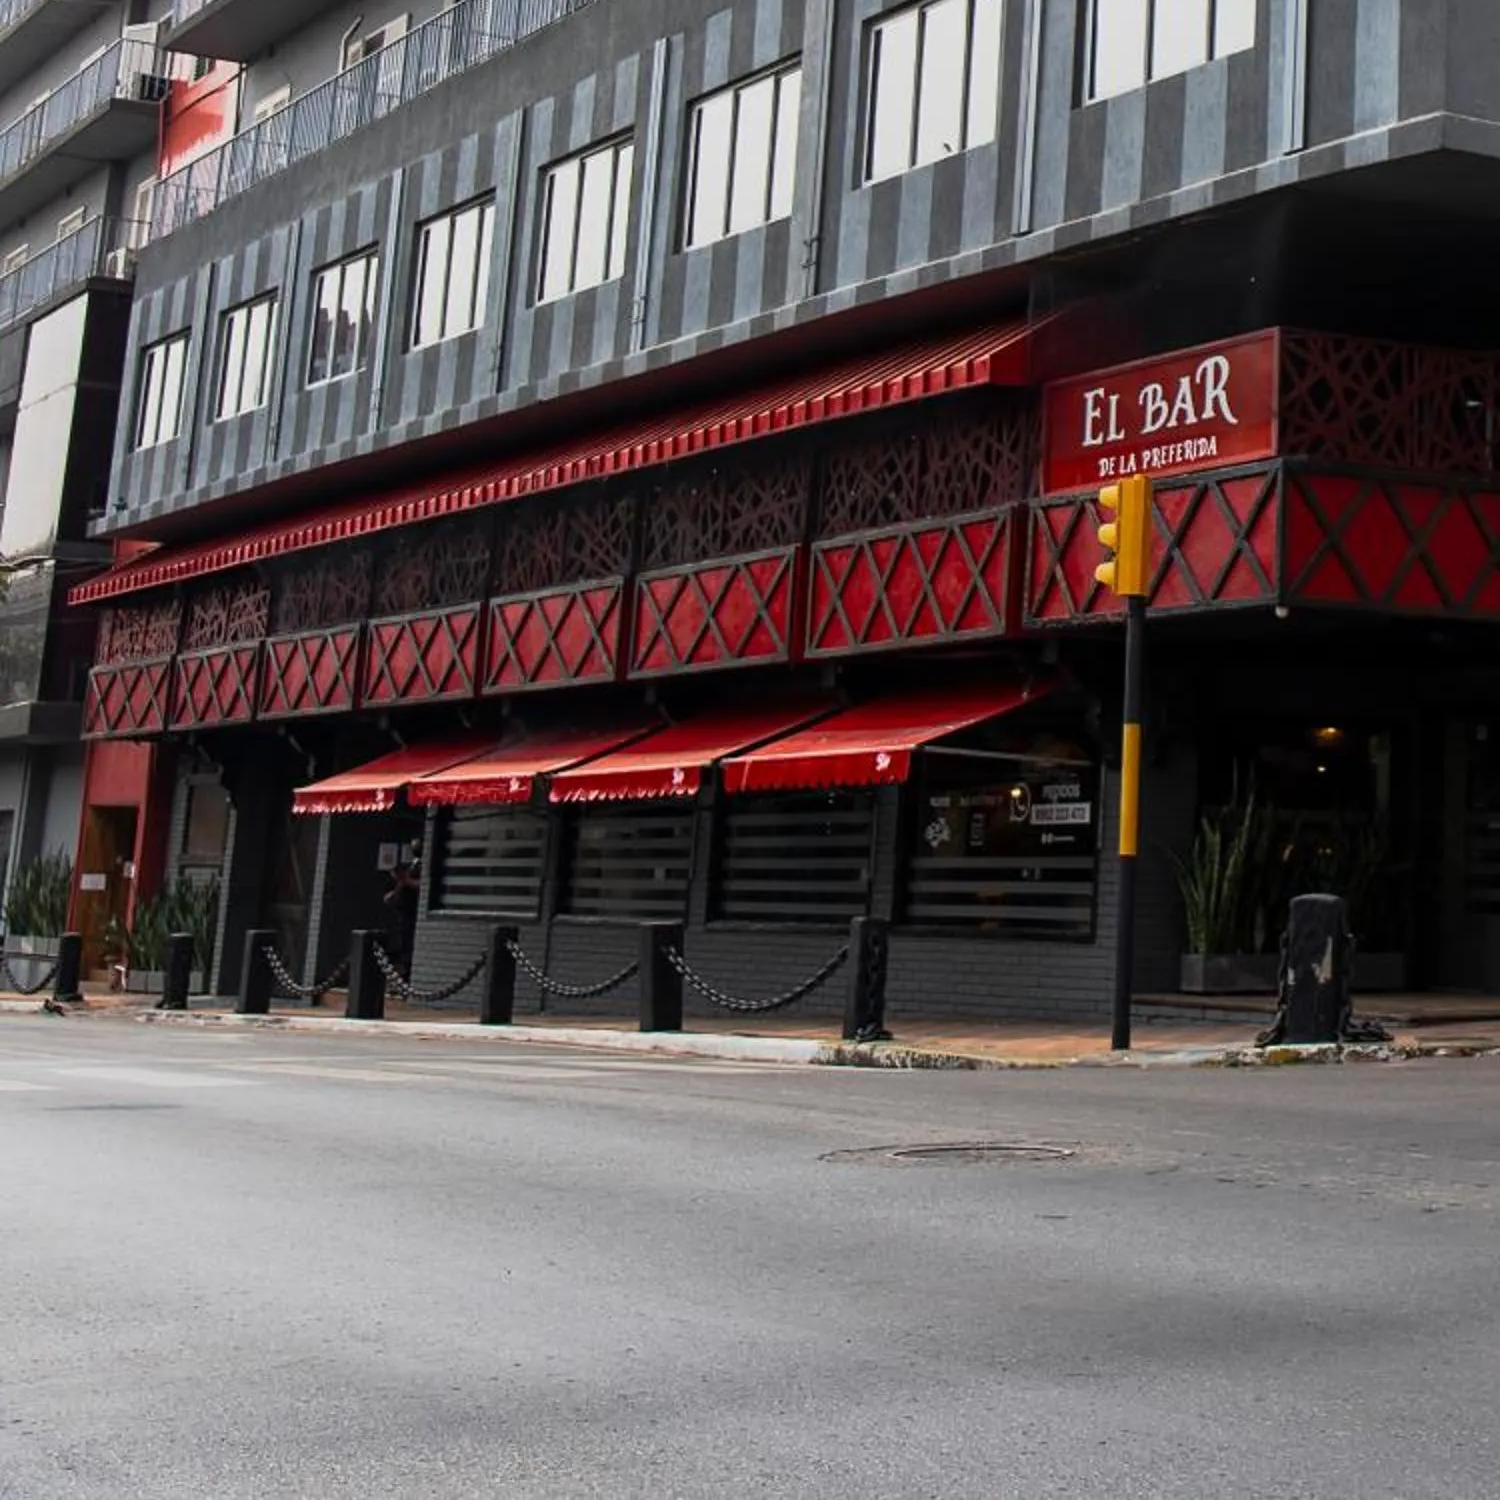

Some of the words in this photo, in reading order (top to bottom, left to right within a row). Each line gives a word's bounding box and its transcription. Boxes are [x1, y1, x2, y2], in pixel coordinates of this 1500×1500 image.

[1082, 387, 1126, 447] EL
[1138, 355, 1239, 434] BAR
[1099, 459, 1117, 477] DE
[1119, 452, 1137, 475] LA
[1142, 435, 1217, 470] PREFERIDA
